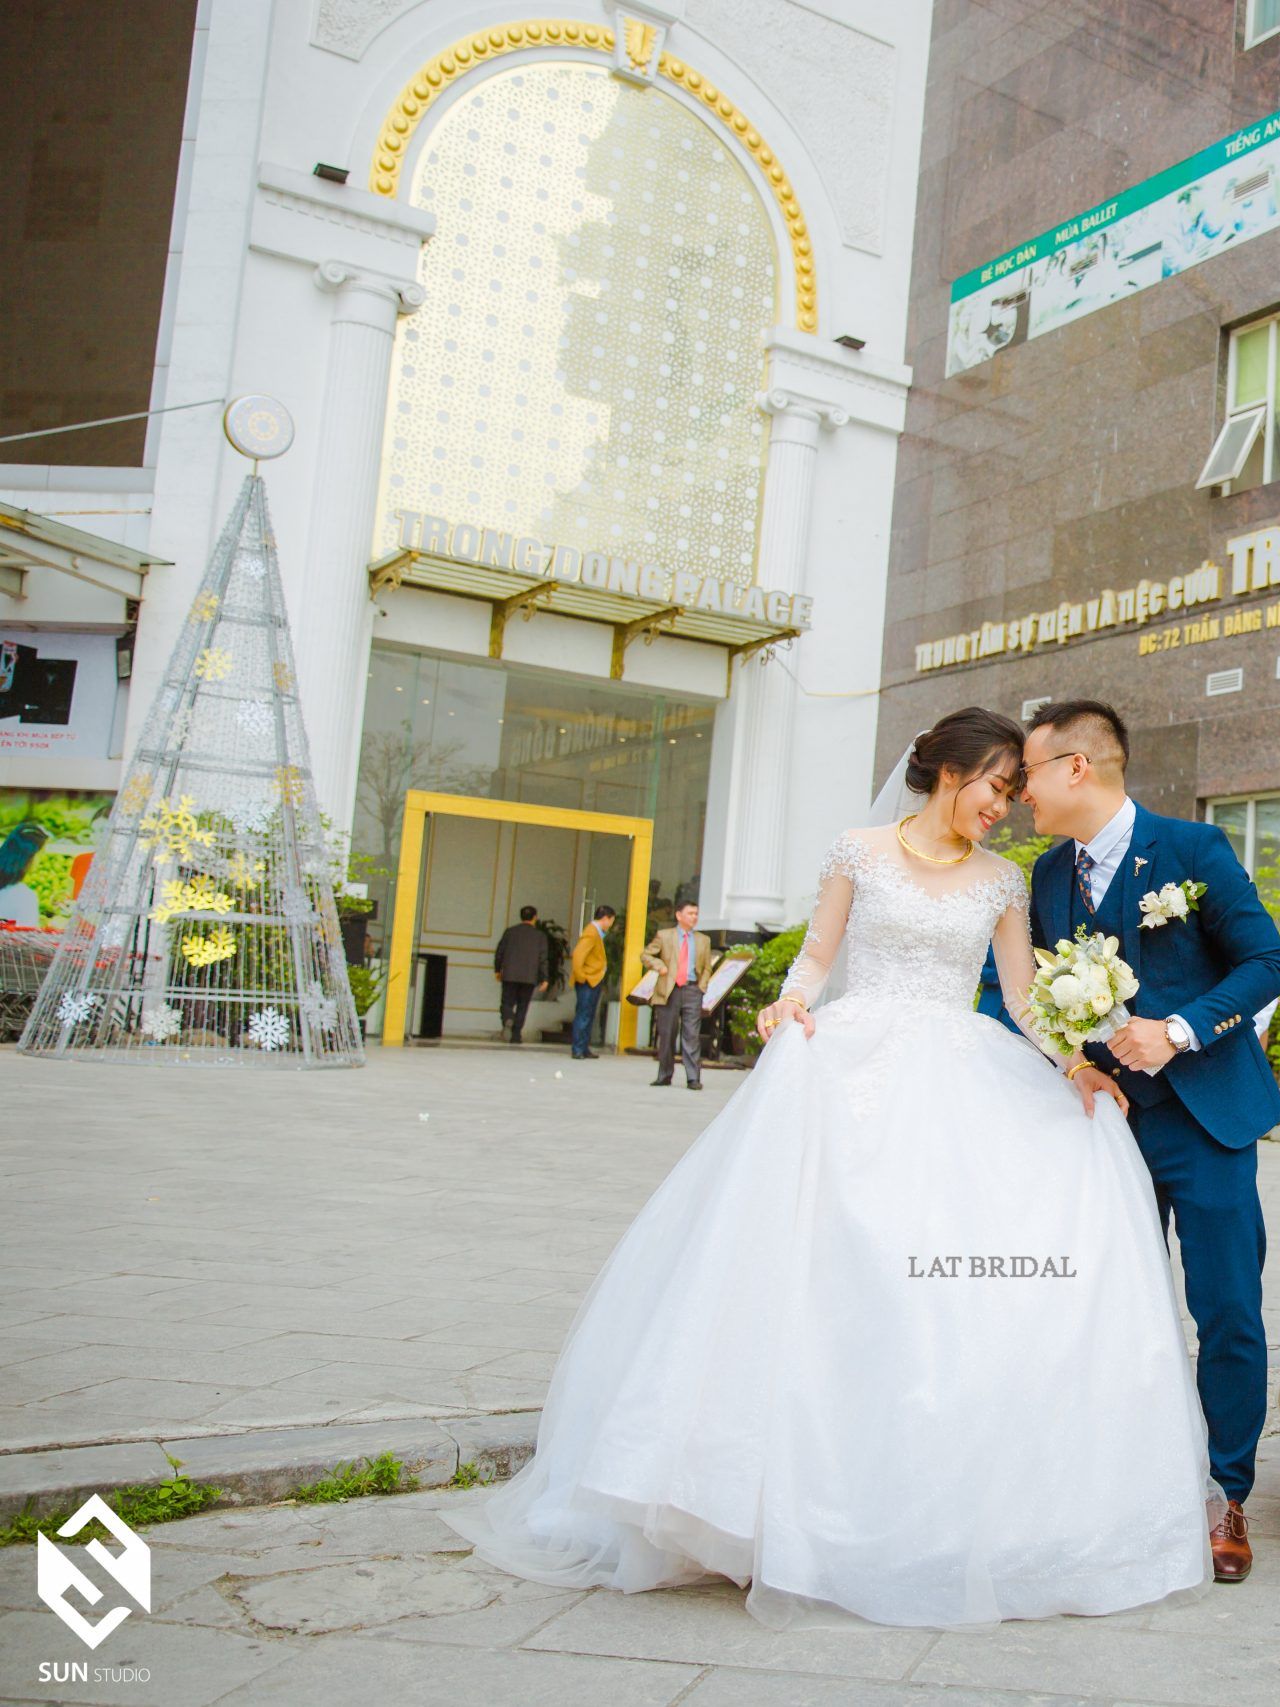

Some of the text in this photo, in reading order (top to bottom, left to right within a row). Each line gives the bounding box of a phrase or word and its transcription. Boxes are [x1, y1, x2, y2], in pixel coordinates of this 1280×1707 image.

[1225, 128, 1260, 158] TIẾNG
[1081, 202, 1118, 233] BALLET
[981, 264, 994, 284] BÉ
[994, 255, 1016, 277] HỌC
[394, 509, 814, 630] TRONG DONG PALACE
[915, 633, 970, 673] TRUNG
[970, 621, 1007, 660] TÂM
[1038, 601, 1085, 645] KIỆN
[1117, 578, 1166, 624] TIỆC
